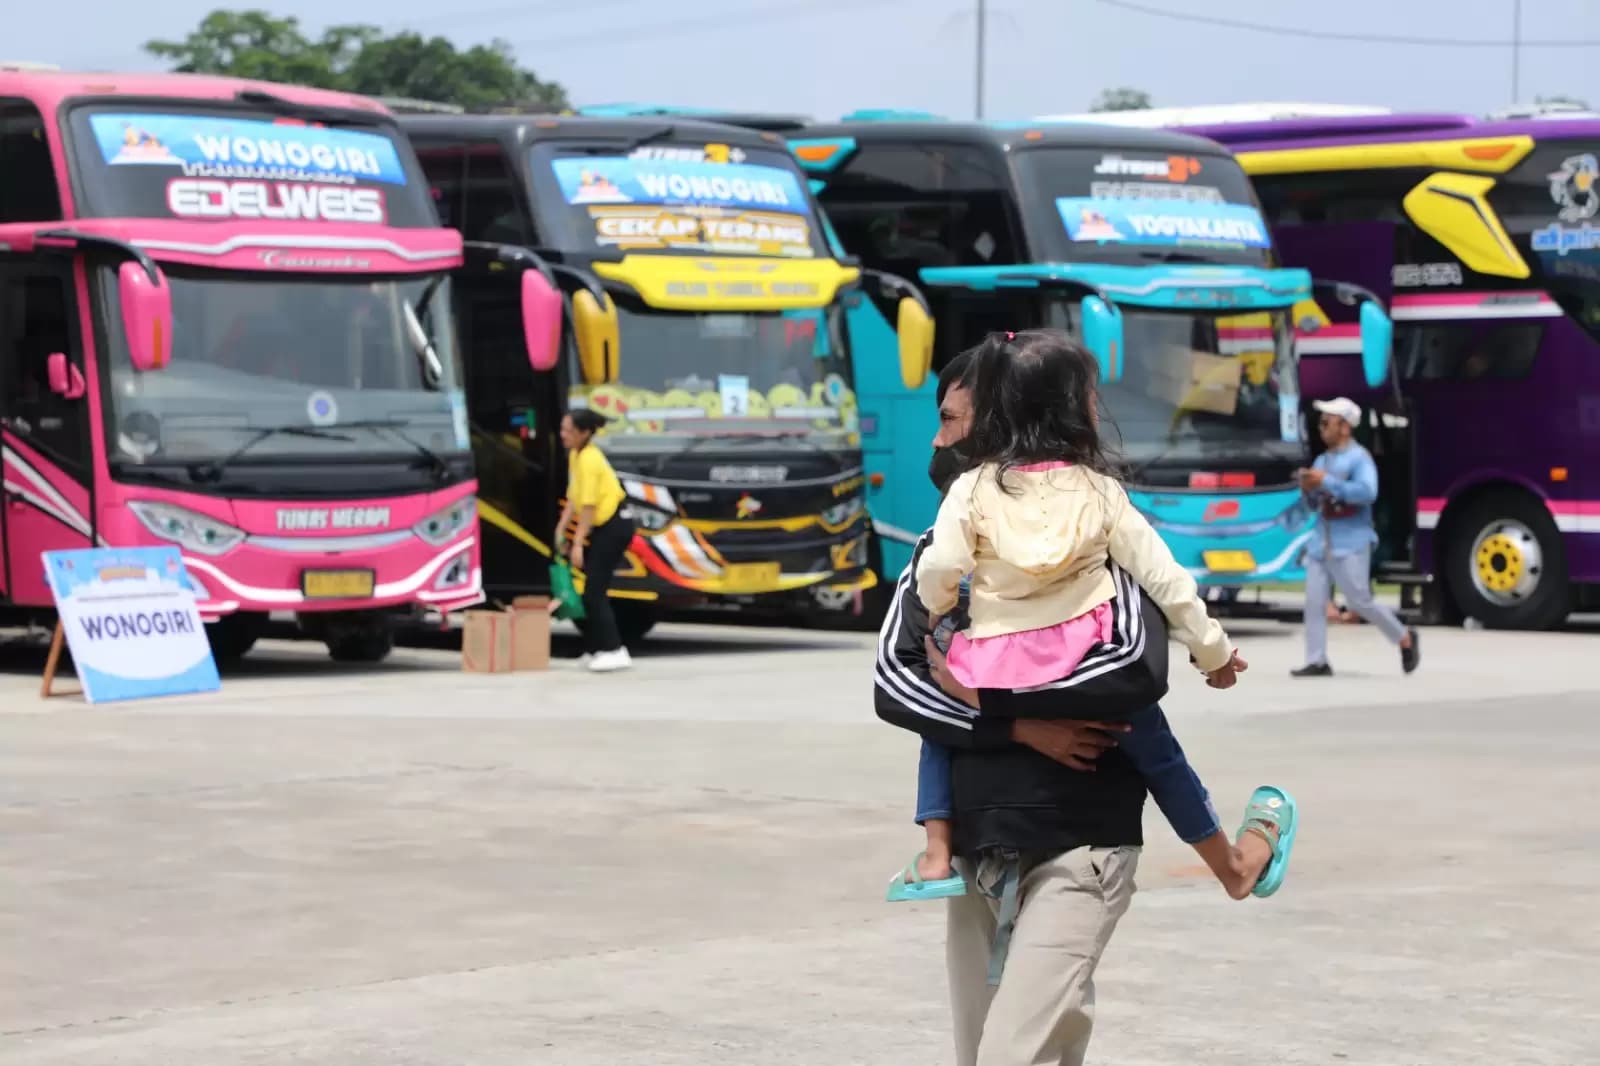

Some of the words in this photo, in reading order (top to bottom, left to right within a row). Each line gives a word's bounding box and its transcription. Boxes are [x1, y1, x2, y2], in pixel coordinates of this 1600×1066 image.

[193, 134, 381, 175] WONOGIRI
[169, 180, 384, 223] EDELWEIS
[636, 173, 789, 205] WONOGIRI
[1127, 215, 1264, 242] YOGYAKARTA
[79, 608, 196, 641] WONOGIRI
